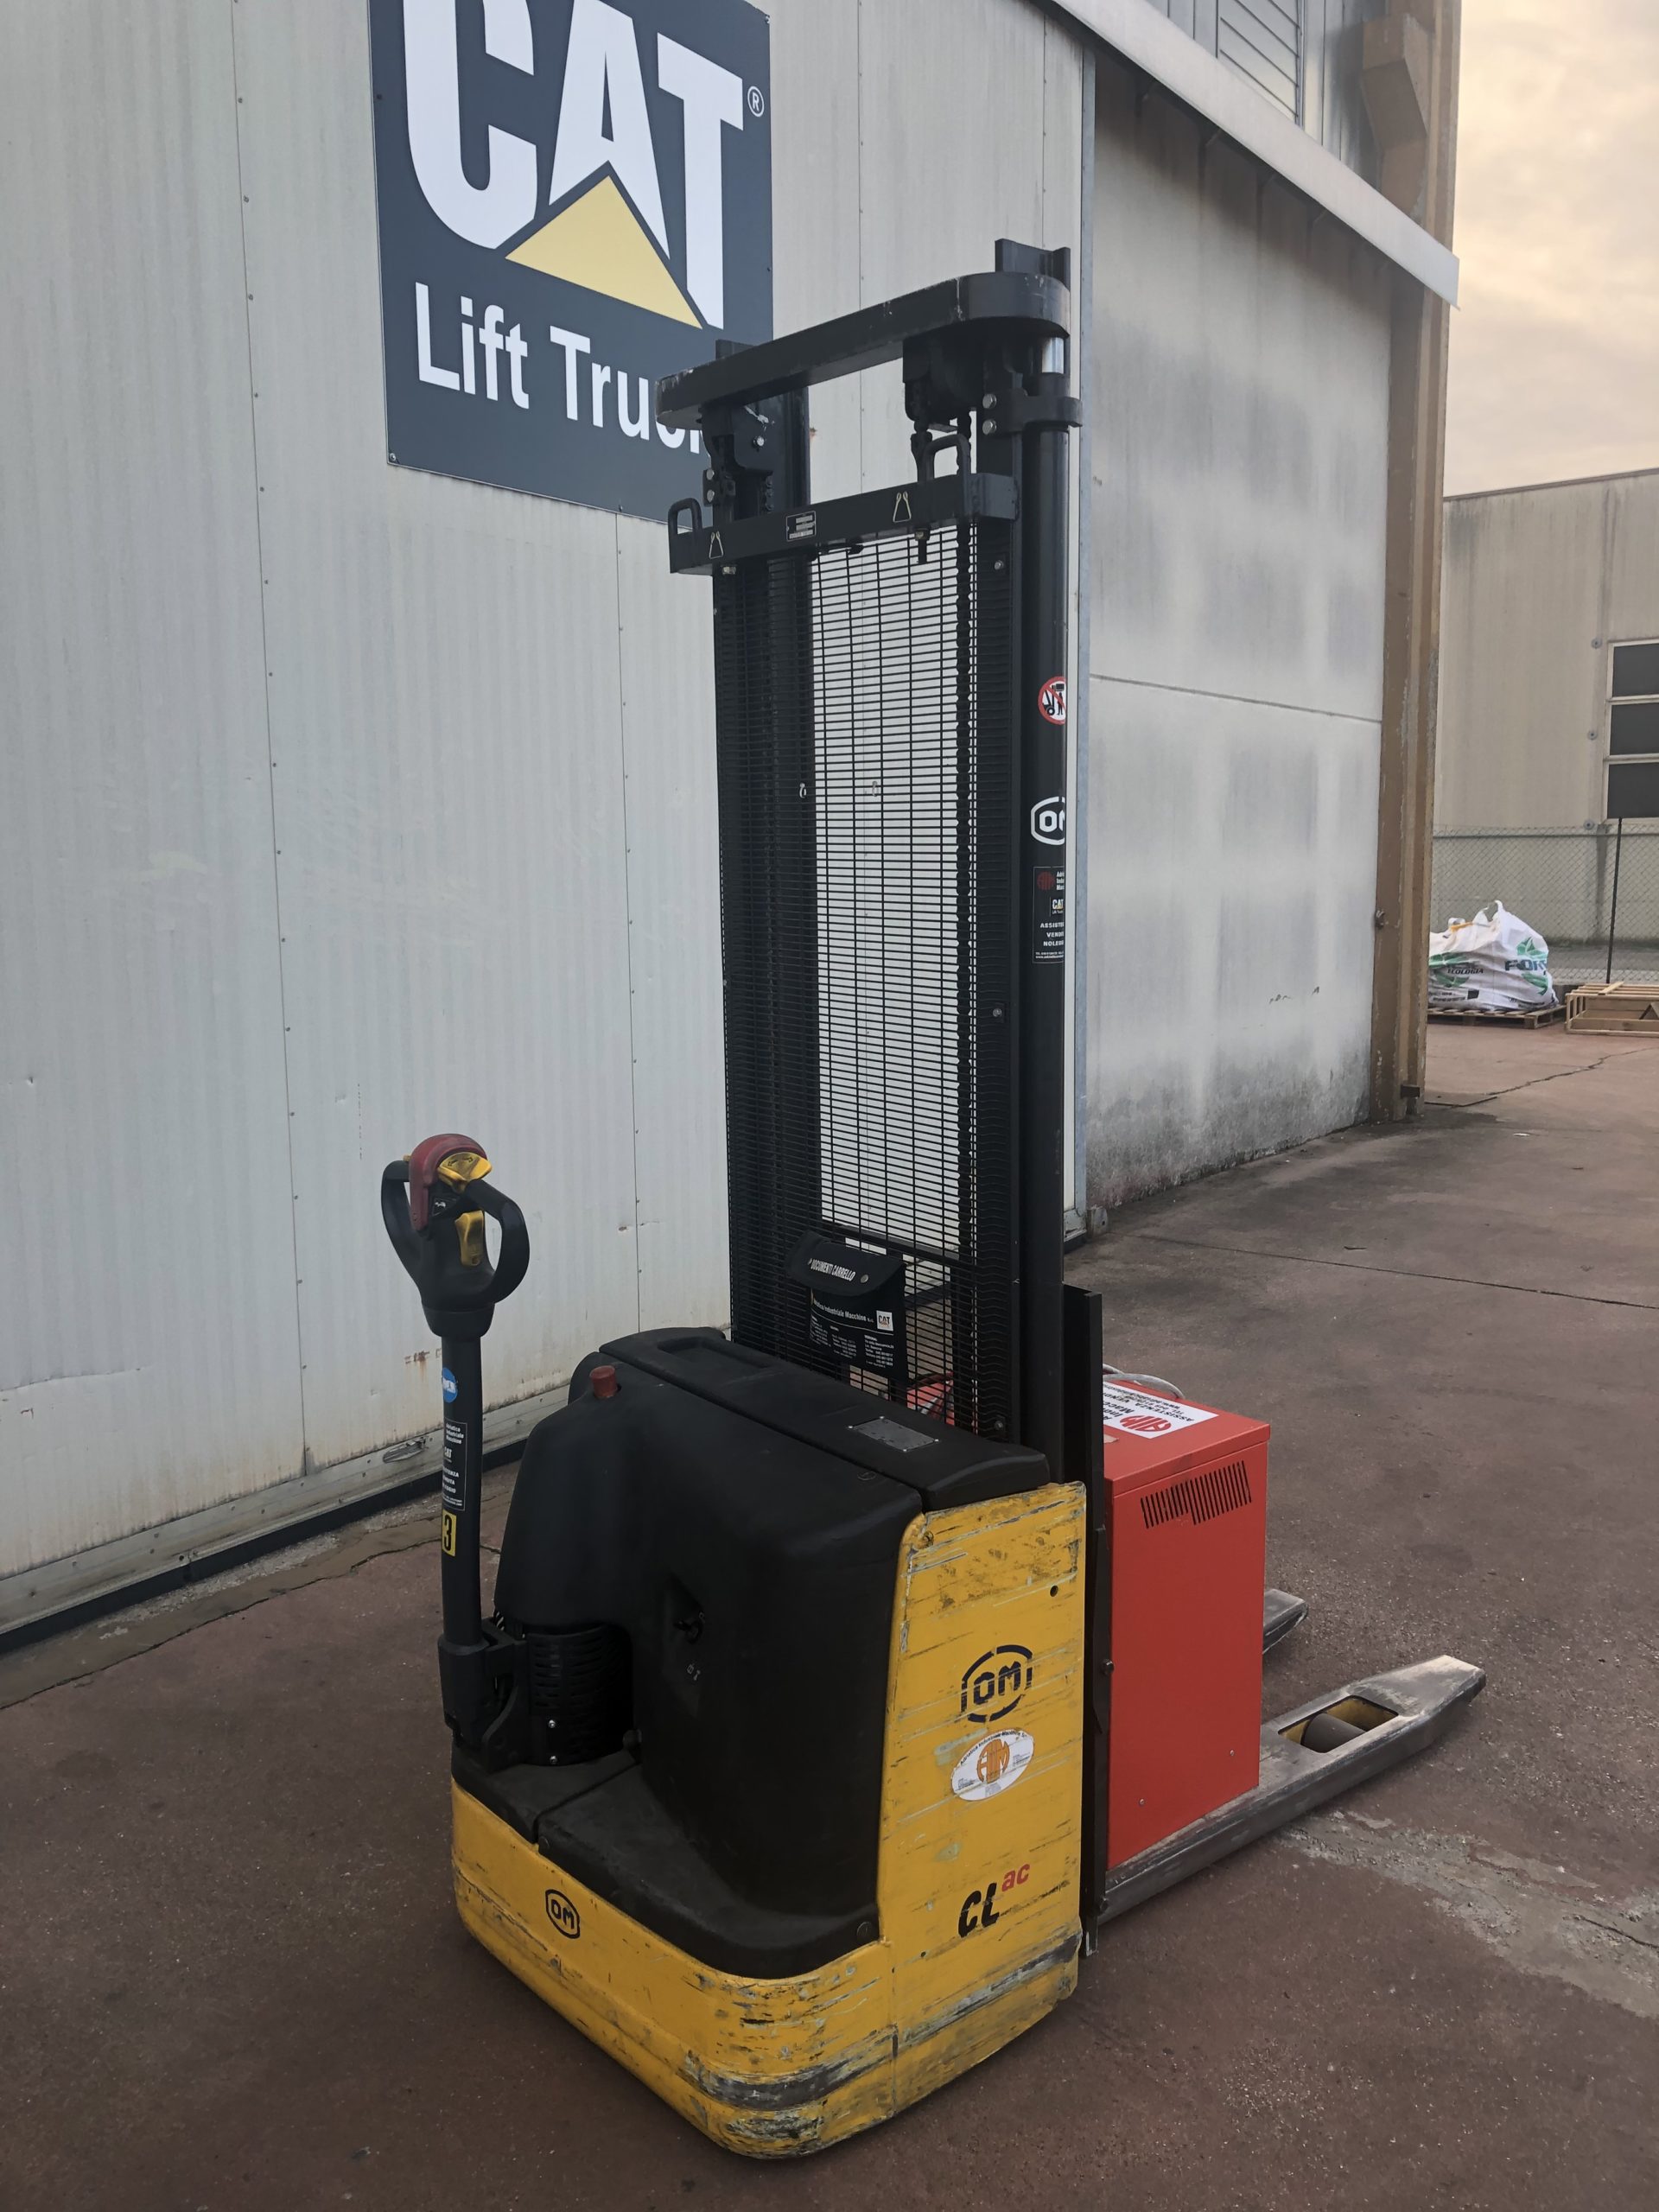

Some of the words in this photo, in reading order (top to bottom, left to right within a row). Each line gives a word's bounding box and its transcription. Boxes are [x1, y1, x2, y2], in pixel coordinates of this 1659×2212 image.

[403, 0, 744, 330] CAT
[415, 281, 530, 410] Lift
[550, 324, 707, 454] Tru
[831, 1264, 856, 1282] CARRELLO
[878, 1315, 891, 1326] CAT
[1135, 1402, 1195, 1421] ASSISTENZA
[443, 1514, 453, 1552] 3
[973, 1659, 1021, 1705] OM
[550, 1898, 575, 1929] OM
[958, 1882, 1000, 1937] CL
[1001, 1862, 1031, 1891] ac
